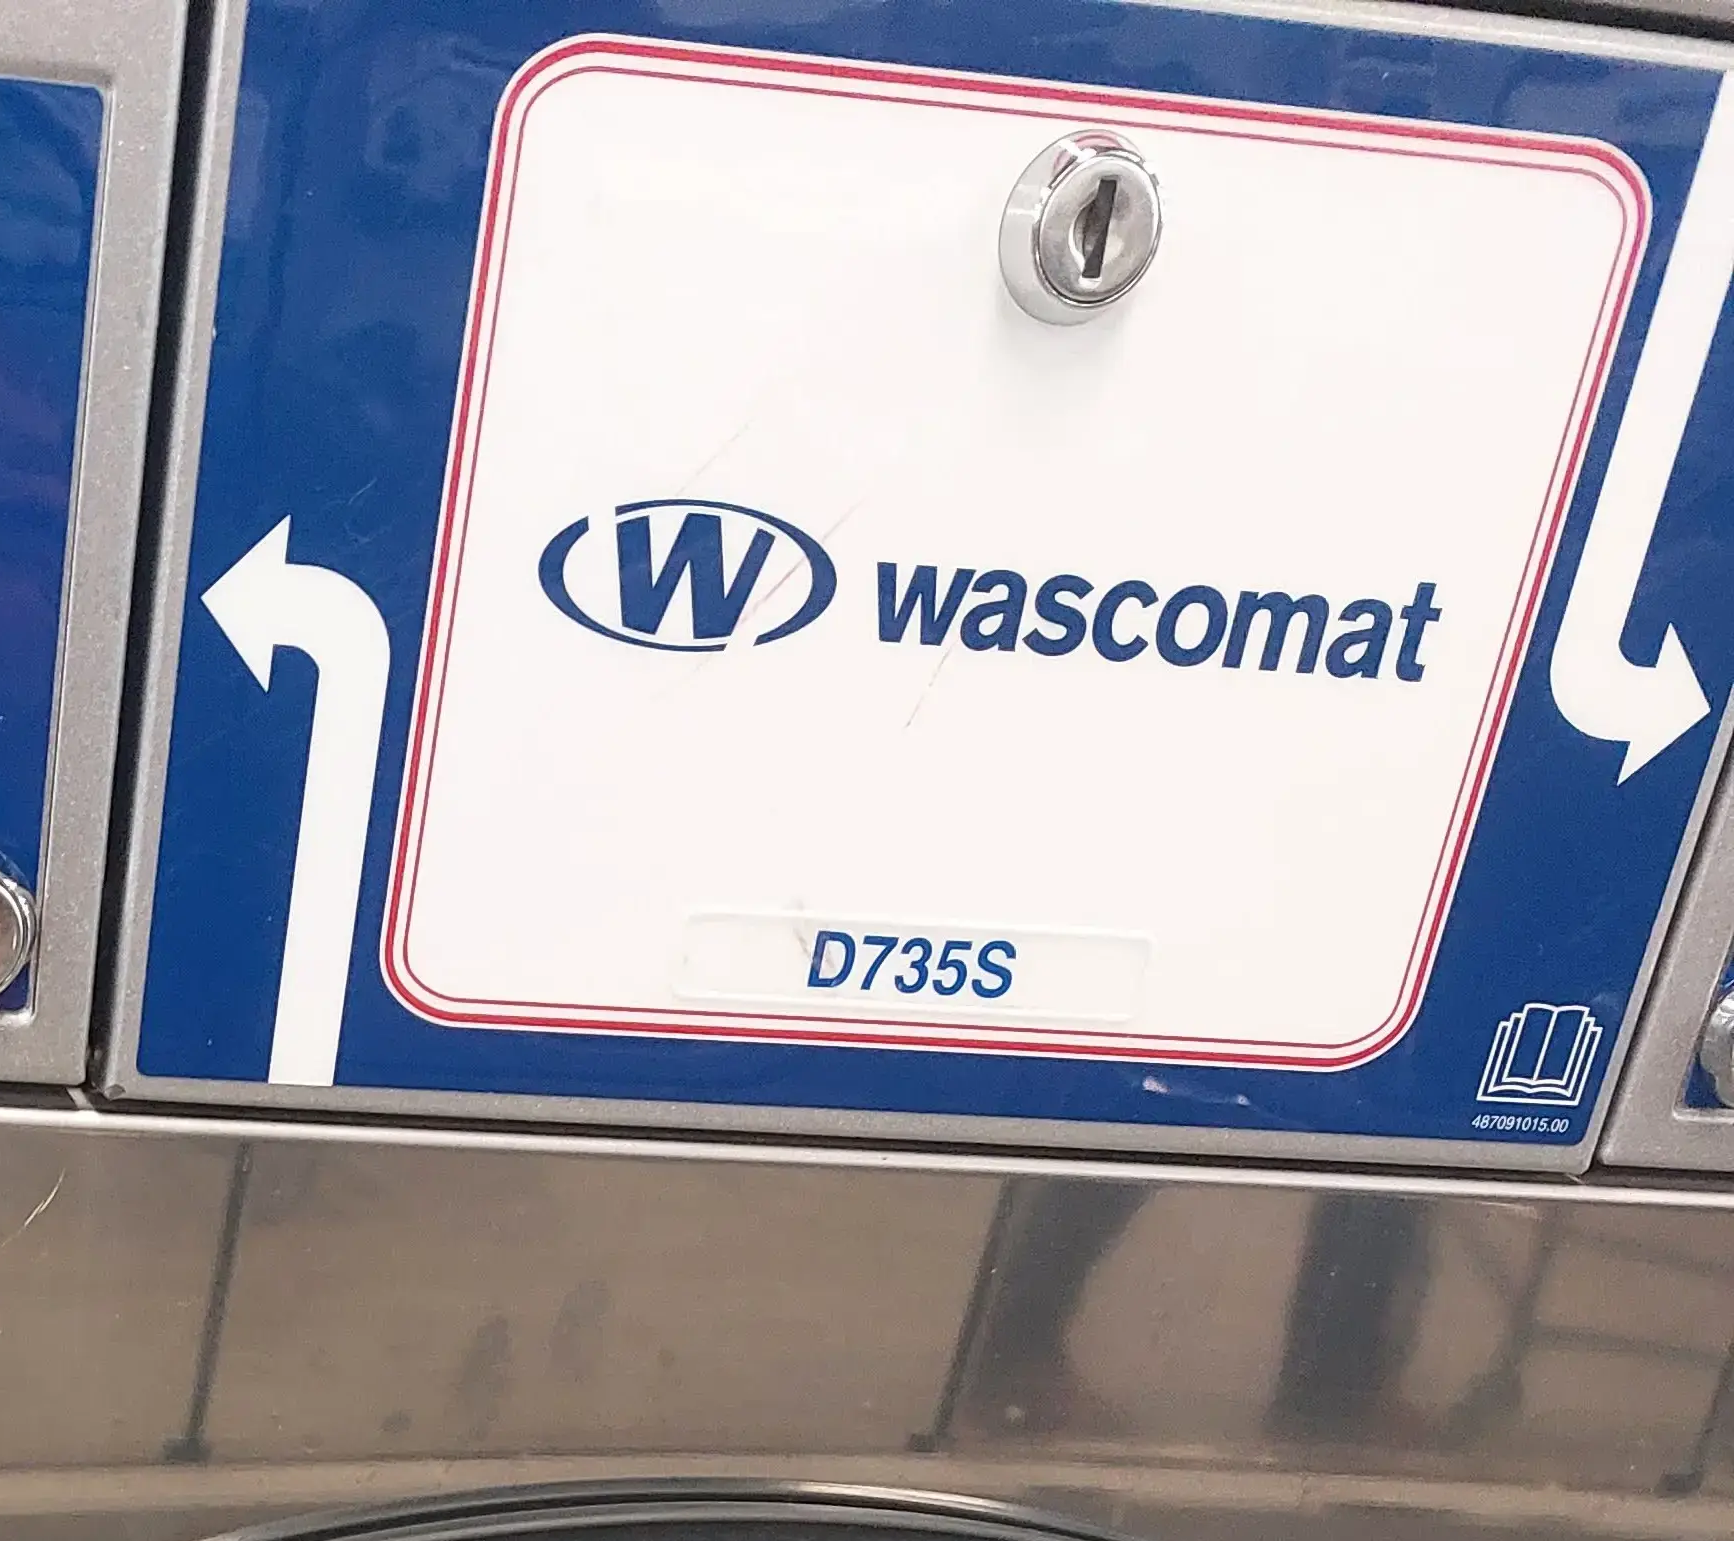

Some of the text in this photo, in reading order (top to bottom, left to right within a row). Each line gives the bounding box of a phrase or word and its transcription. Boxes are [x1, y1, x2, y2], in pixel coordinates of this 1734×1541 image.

[875, 561, 1443, 683] wascomat
[806, 930, 1017, 999] D735S
[1471, 1114, 1570, 1133] 487091015.00
